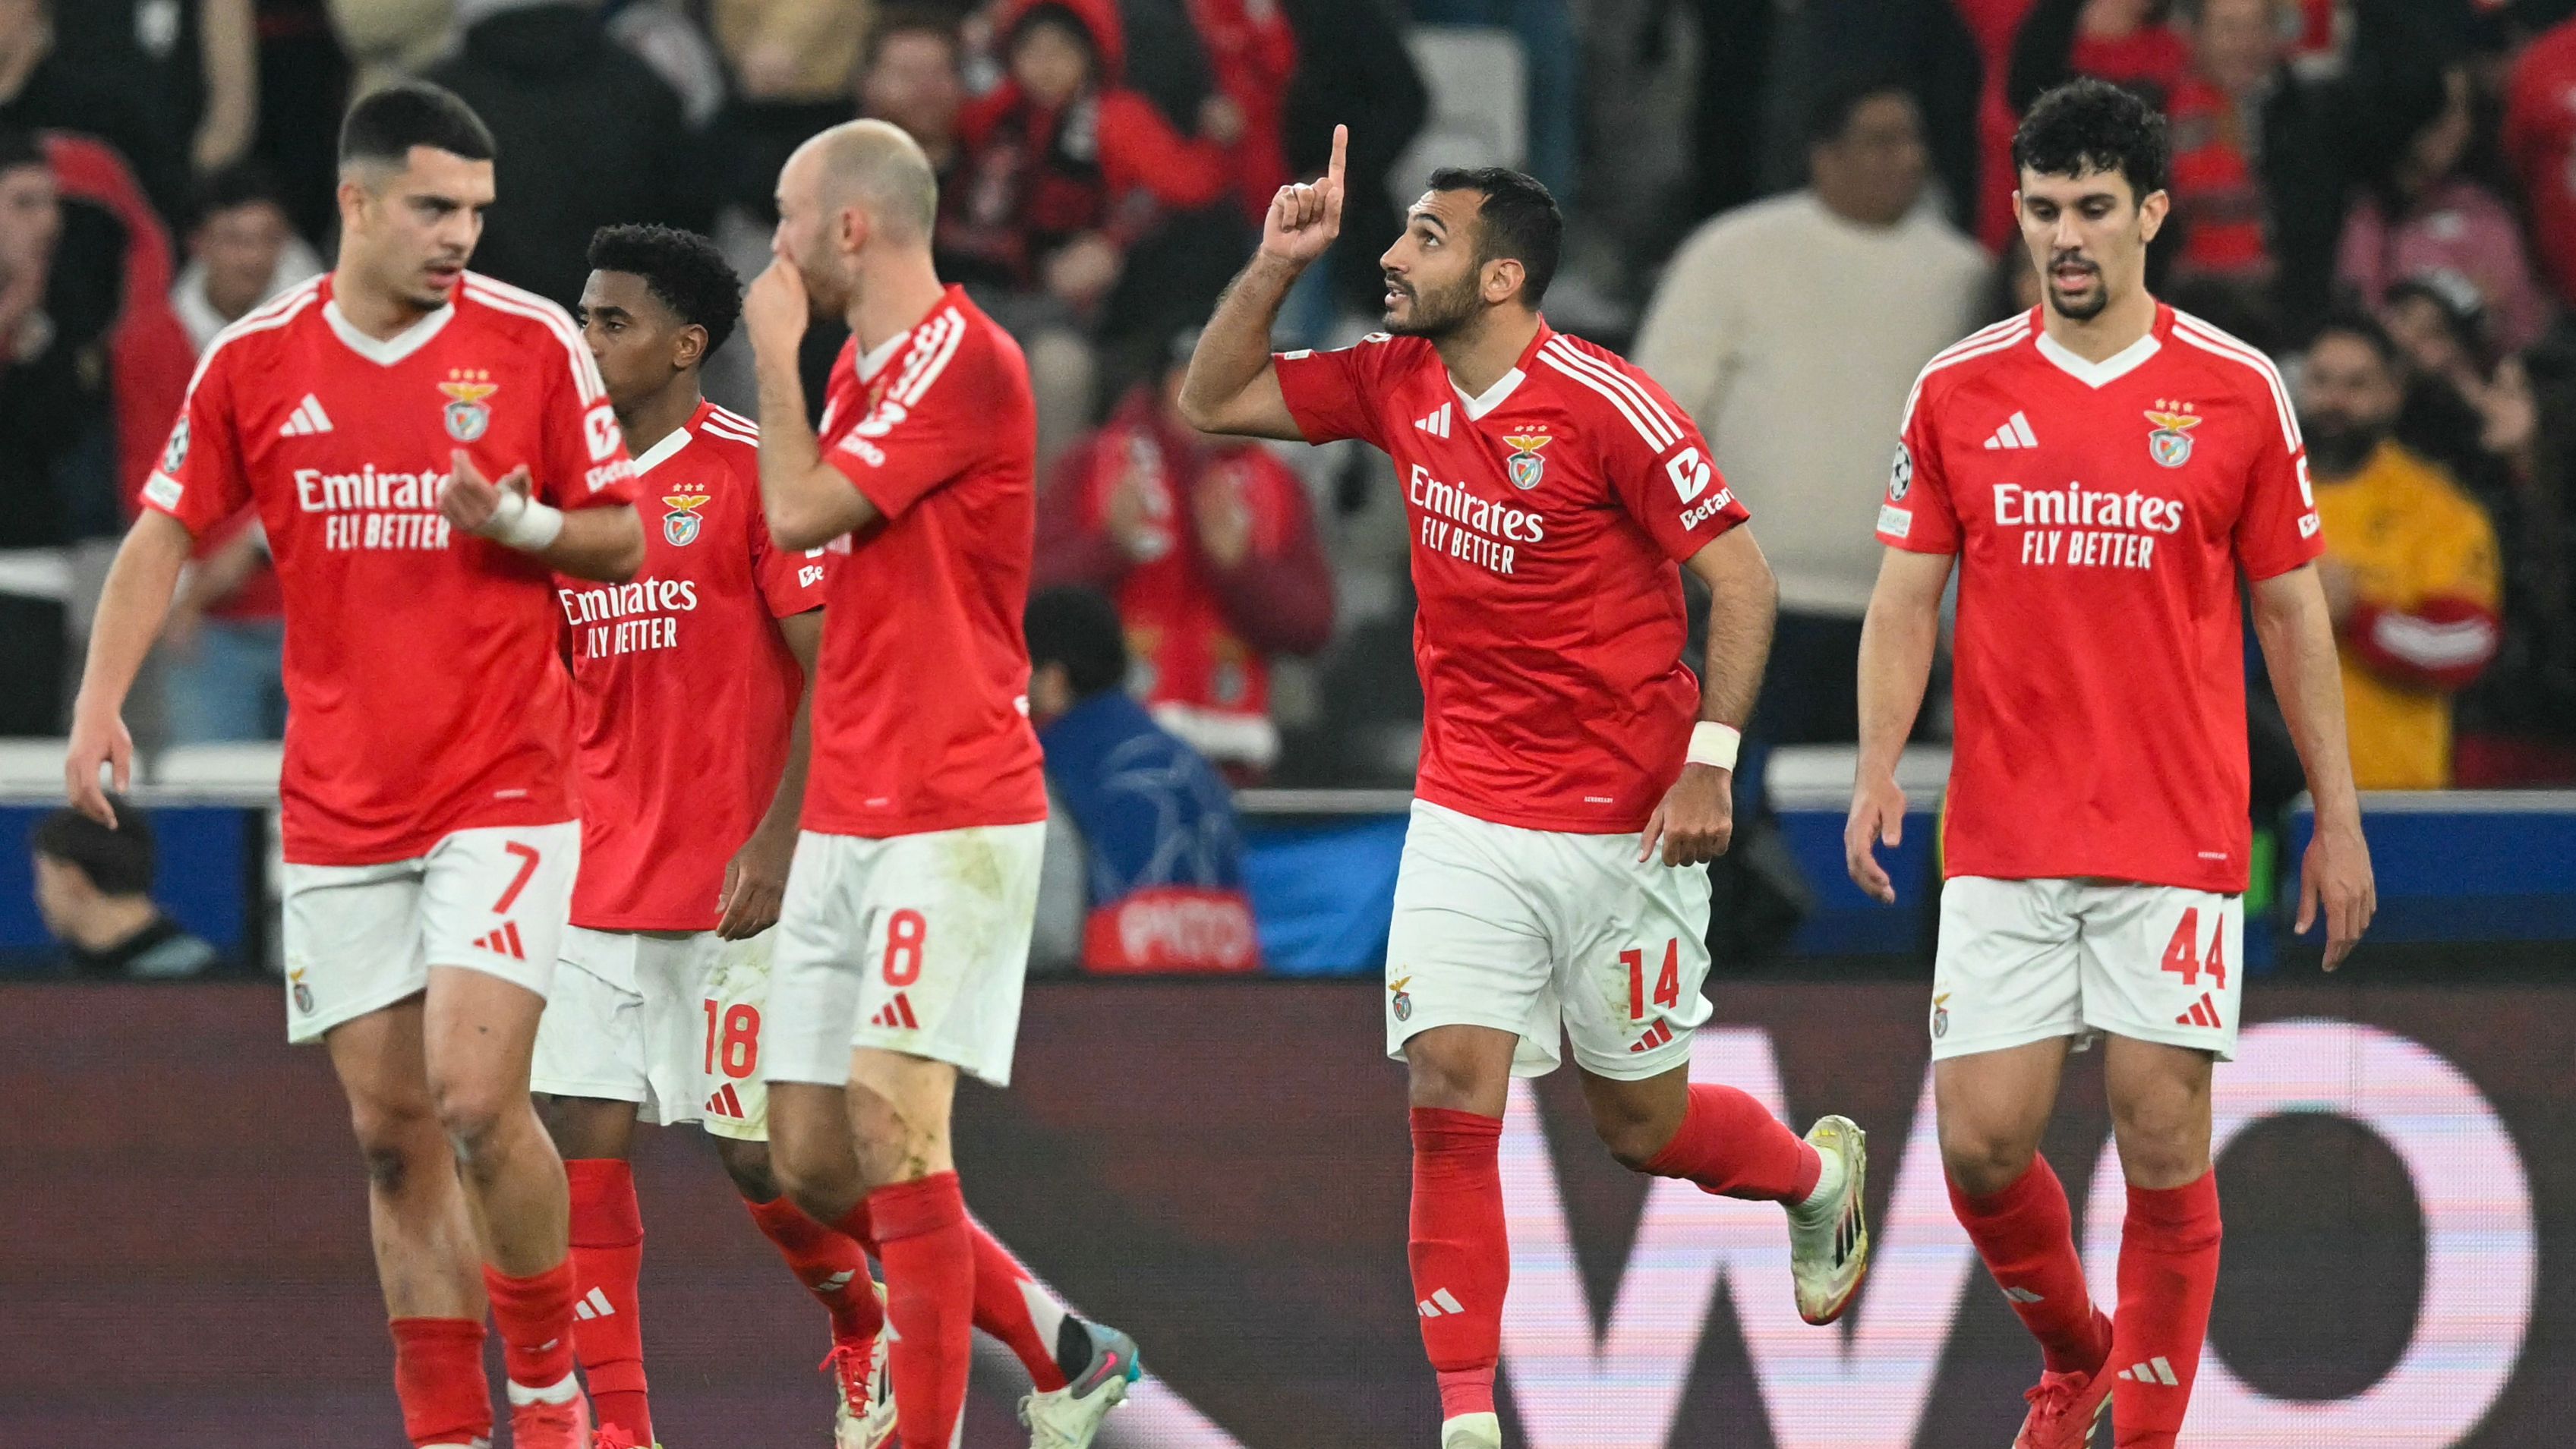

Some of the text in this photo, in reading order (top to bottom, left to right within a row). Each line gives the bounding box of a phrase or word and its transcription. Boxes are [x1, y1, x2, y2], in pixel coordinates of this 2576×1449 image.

[294, 463, 451, 512] Emirat
[1410, 463, 1543, 543] Emirates
[1992, 480, 2184, 534] Emirates
[1421, 515, 1515, 575] FLY BETTER
[2022, 531, 2155, 569] FLY BETTER
[558, 575, 698, 625] Emirates
[492, 840, 541, 915] 7
[882, 908, 927, 988] 8
[1619, 937, 1680, 1020] 14
[2161, 907, 2226, 990] 44
[704, 998, 761, 1079] 18
